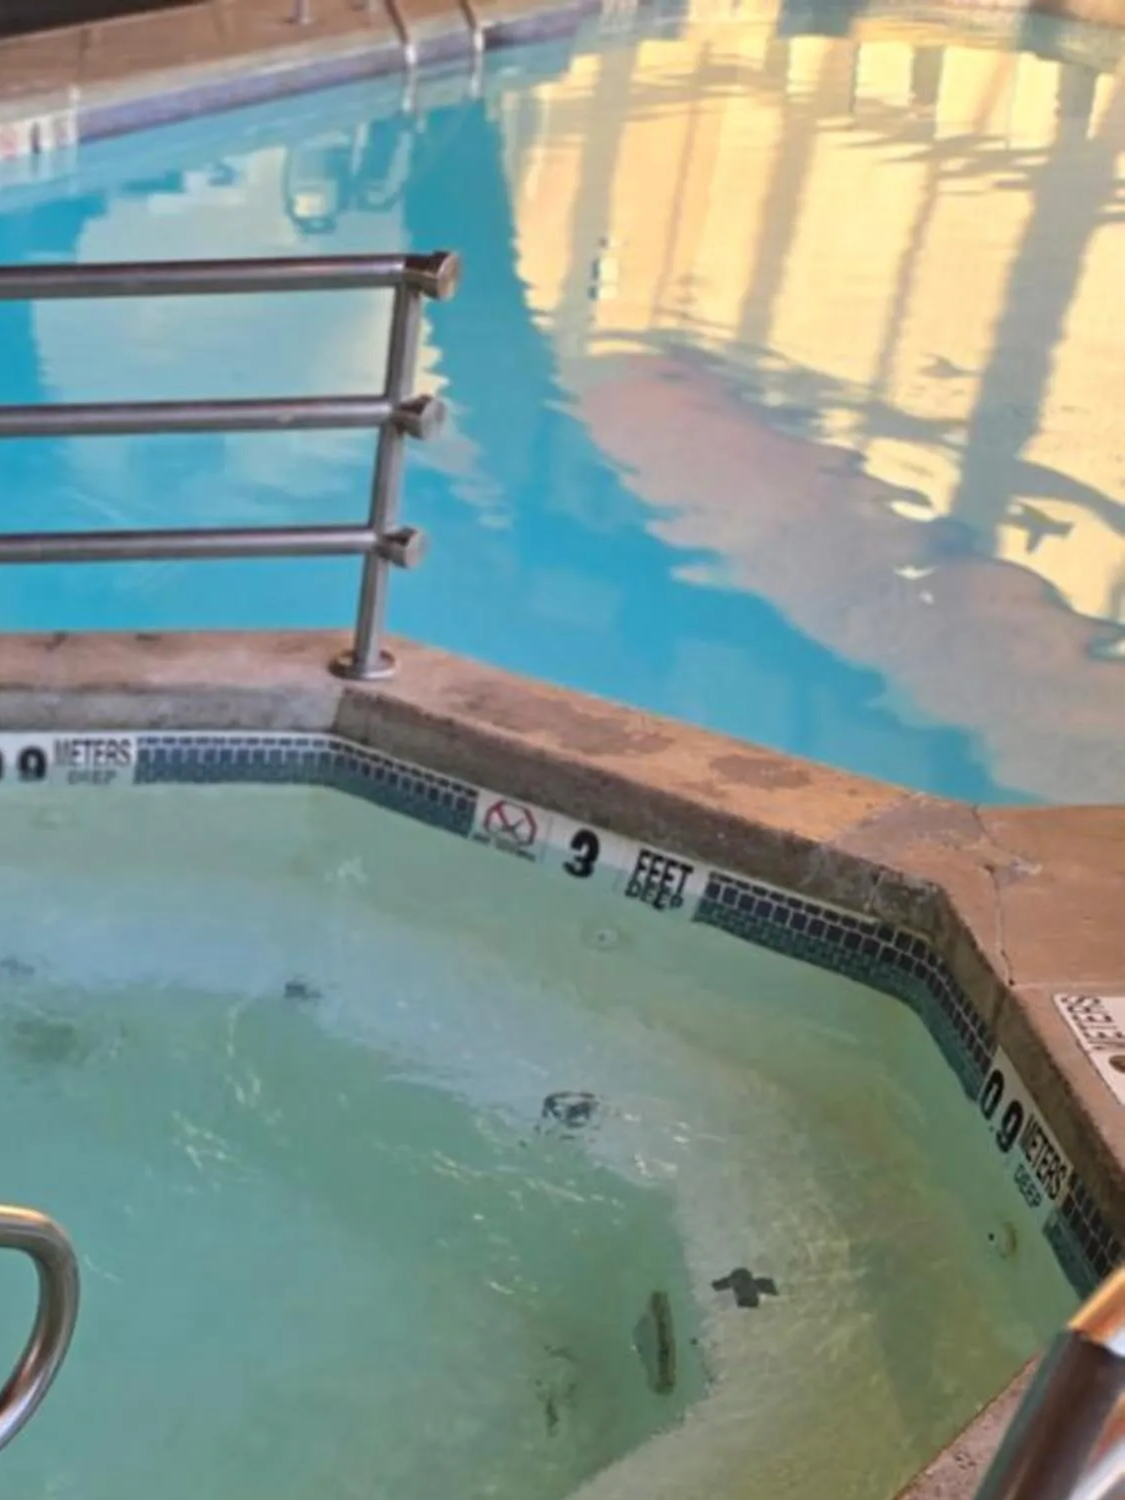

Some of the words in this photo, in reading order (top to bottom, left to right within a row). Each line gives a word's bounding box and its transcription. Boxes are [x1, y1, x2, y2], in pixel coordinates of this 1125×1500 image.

[53, 737, 131, 767] METERS
[562, 829, 600, 878] 3
[633, 848, 694, 895] FEET
[625, 878, 684, 911] DEEP
[1020, 1113, 1067, 1200] METERS
